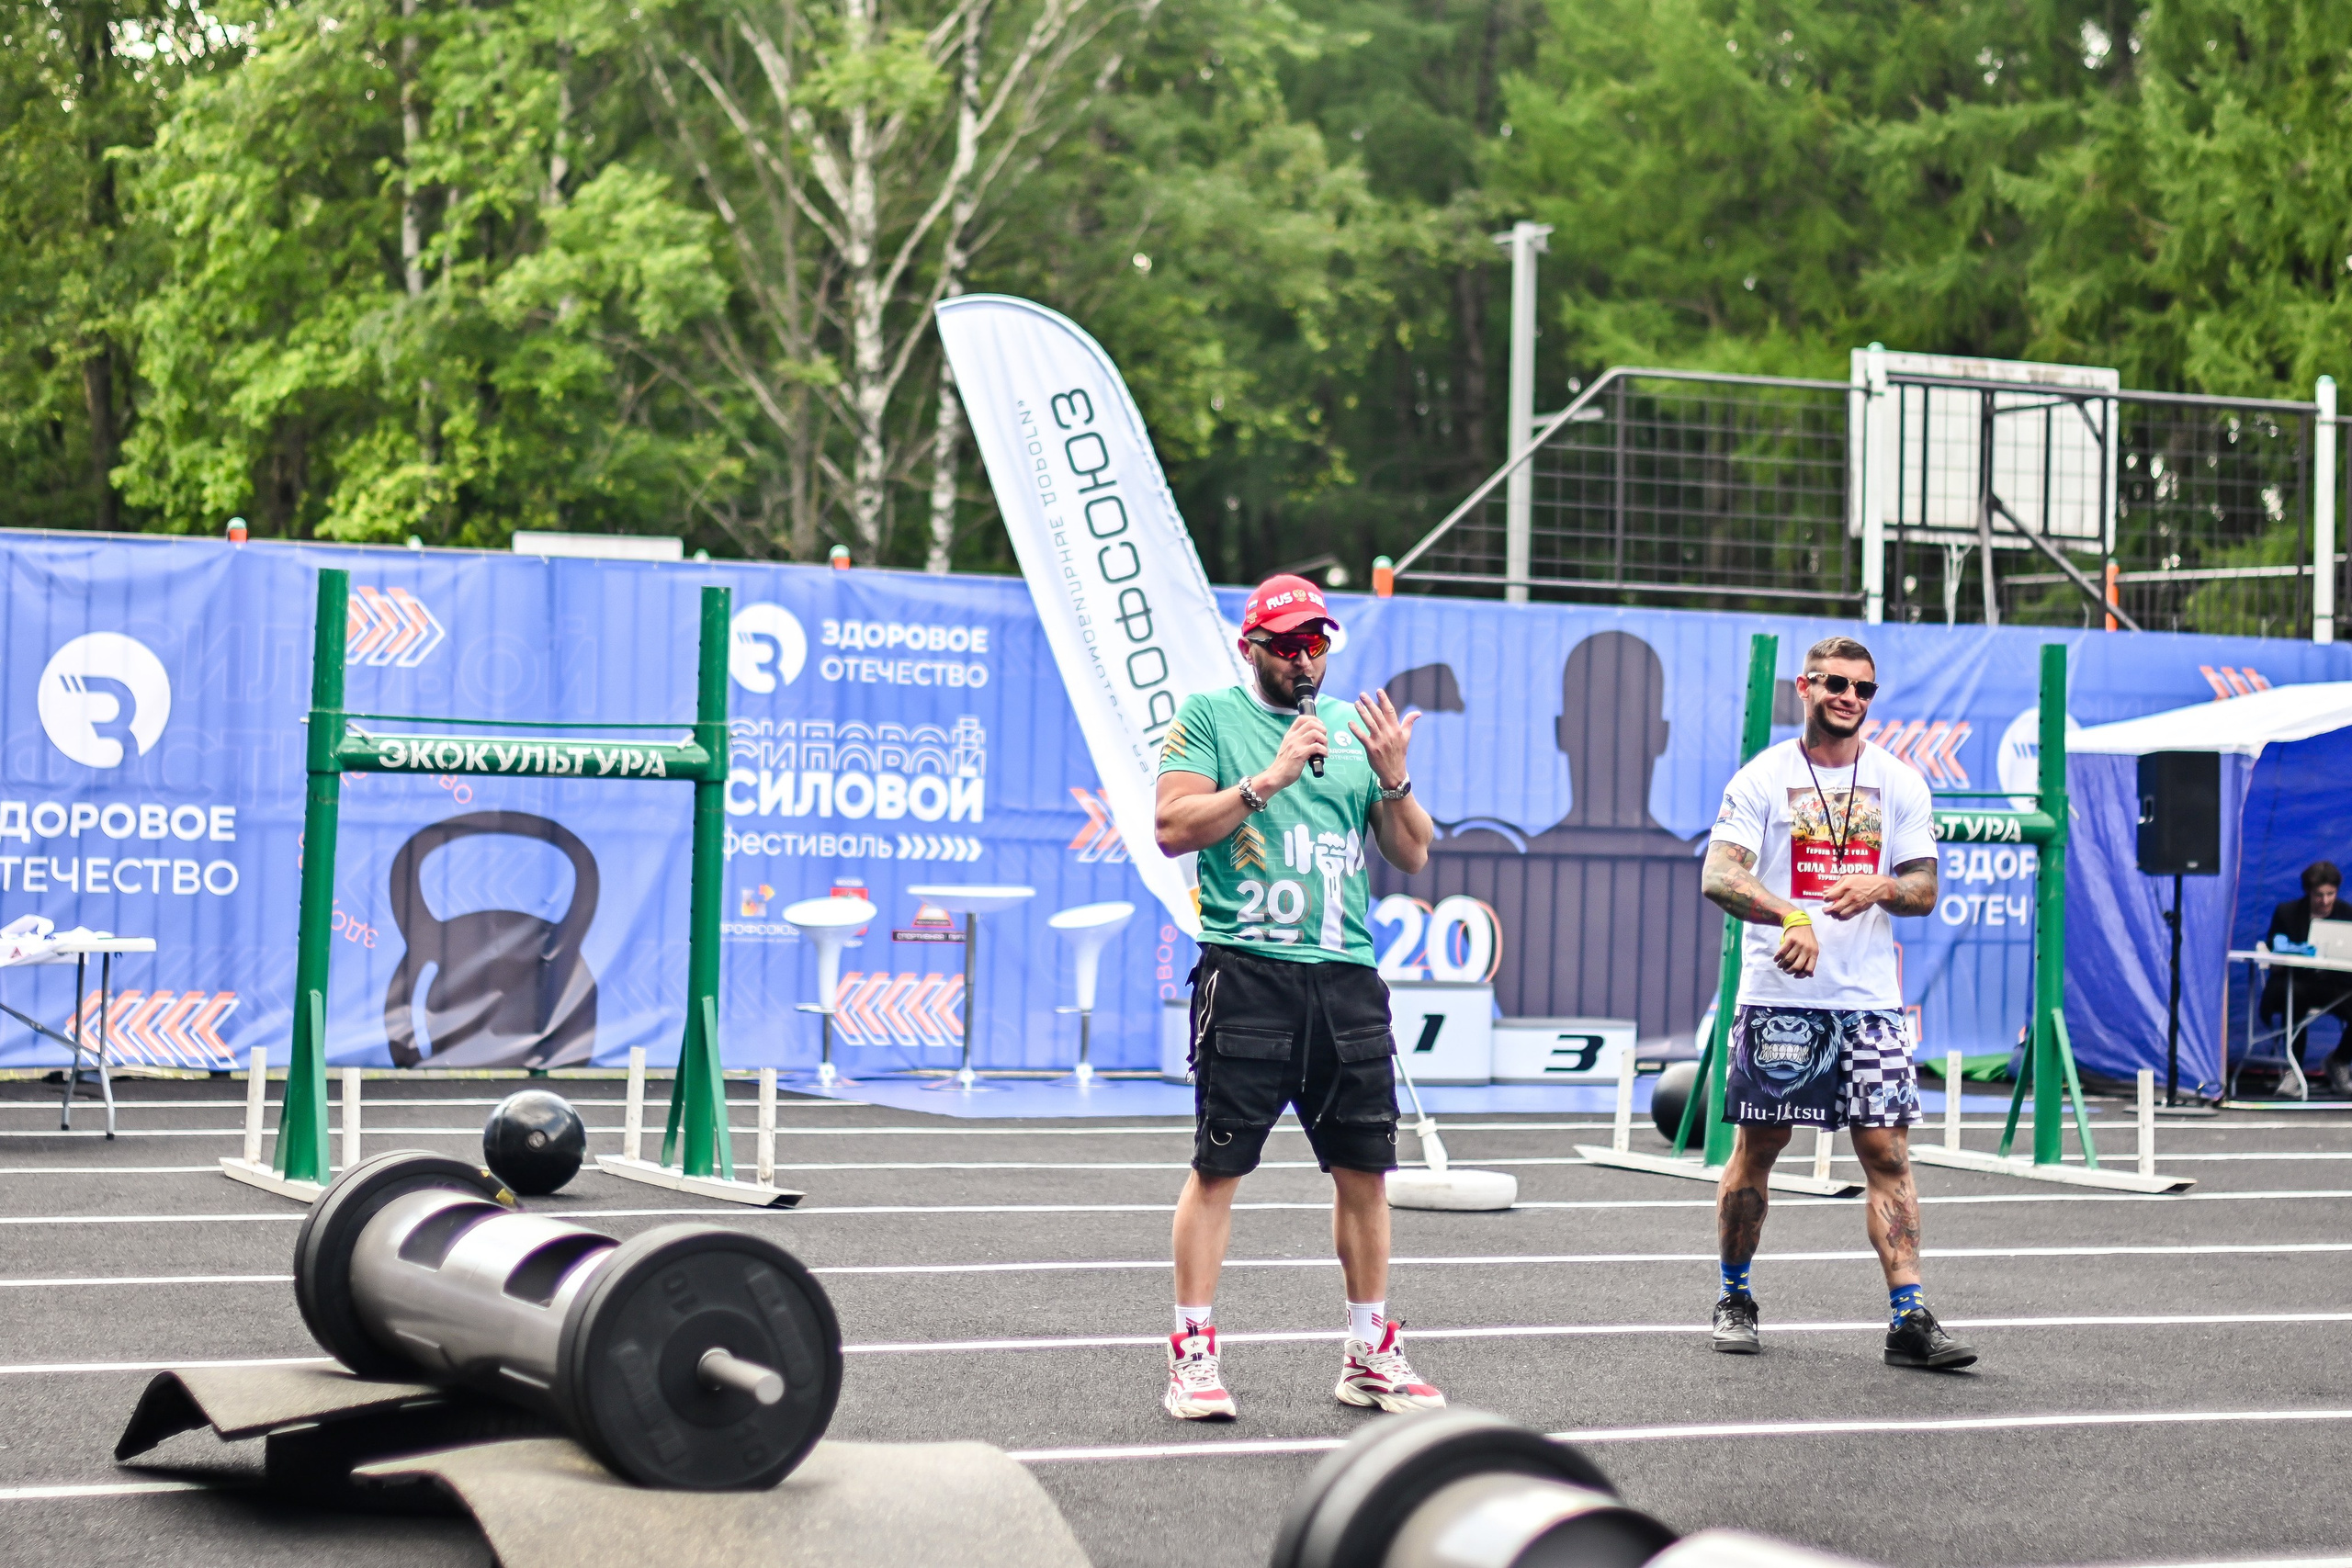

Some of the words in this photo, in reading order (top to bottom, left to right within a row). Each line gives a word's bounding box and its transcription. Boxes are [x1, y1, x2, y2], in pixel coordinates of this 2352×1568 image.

[1266, 592, 1294, 611] RUS
[821, 620, 989, 653] ЗДОРОВОЕ
[820, 657, 989, 689] ОТЕЧЕСТВО
[379, 739, 666, 777] ЭКОКУЛЬТУРА
[724, 766, 985, 823] СИЛОВОЙ
[723, 825, 893, 862] фестиваль
[1797, 862, 1826, 873] СИЛА
[1237, 879, 1306, 925] 20
[1374, 895, 1499, 983] 20
[1414, 1014, 1446, 1054] 1
[1544, 1034, 1606, 1073] 3
